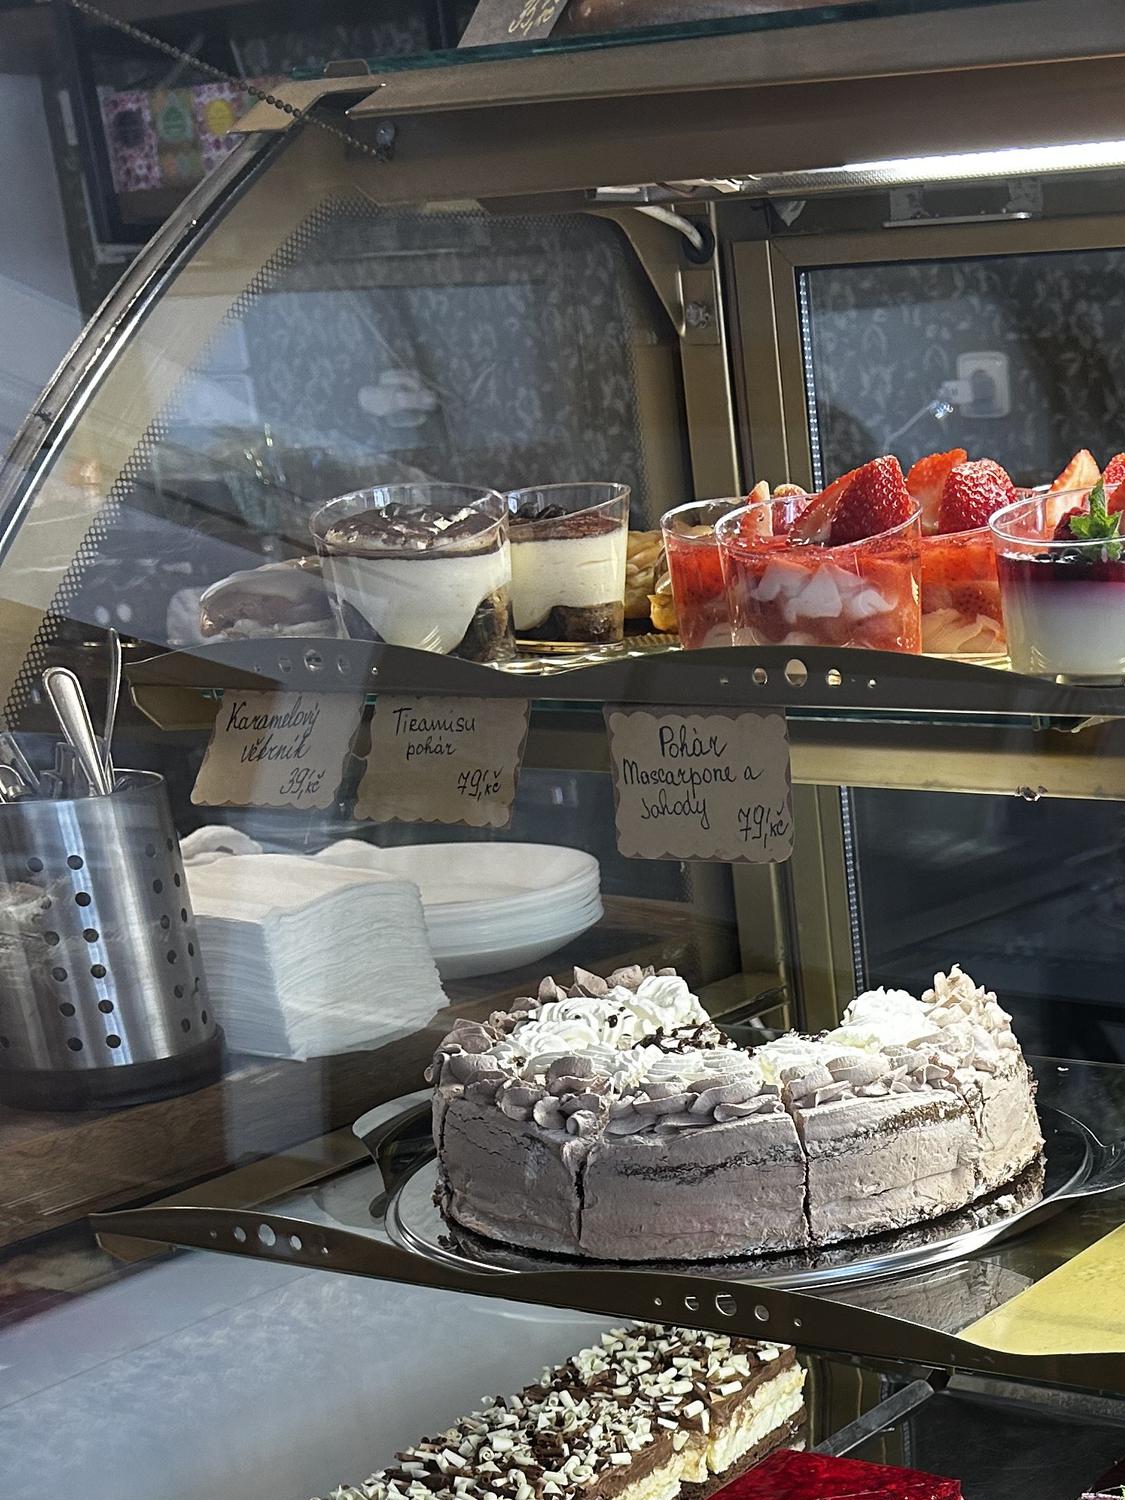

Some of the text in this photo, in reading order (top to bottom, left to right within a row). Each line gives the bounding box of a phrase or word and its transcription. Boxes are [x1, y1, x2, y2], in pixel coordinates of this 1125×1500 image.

[407, 736, 456, 760] pohár
[659, 725, 727, 758] Pohár
[623, 757, 764, 798] Mascarpone a
